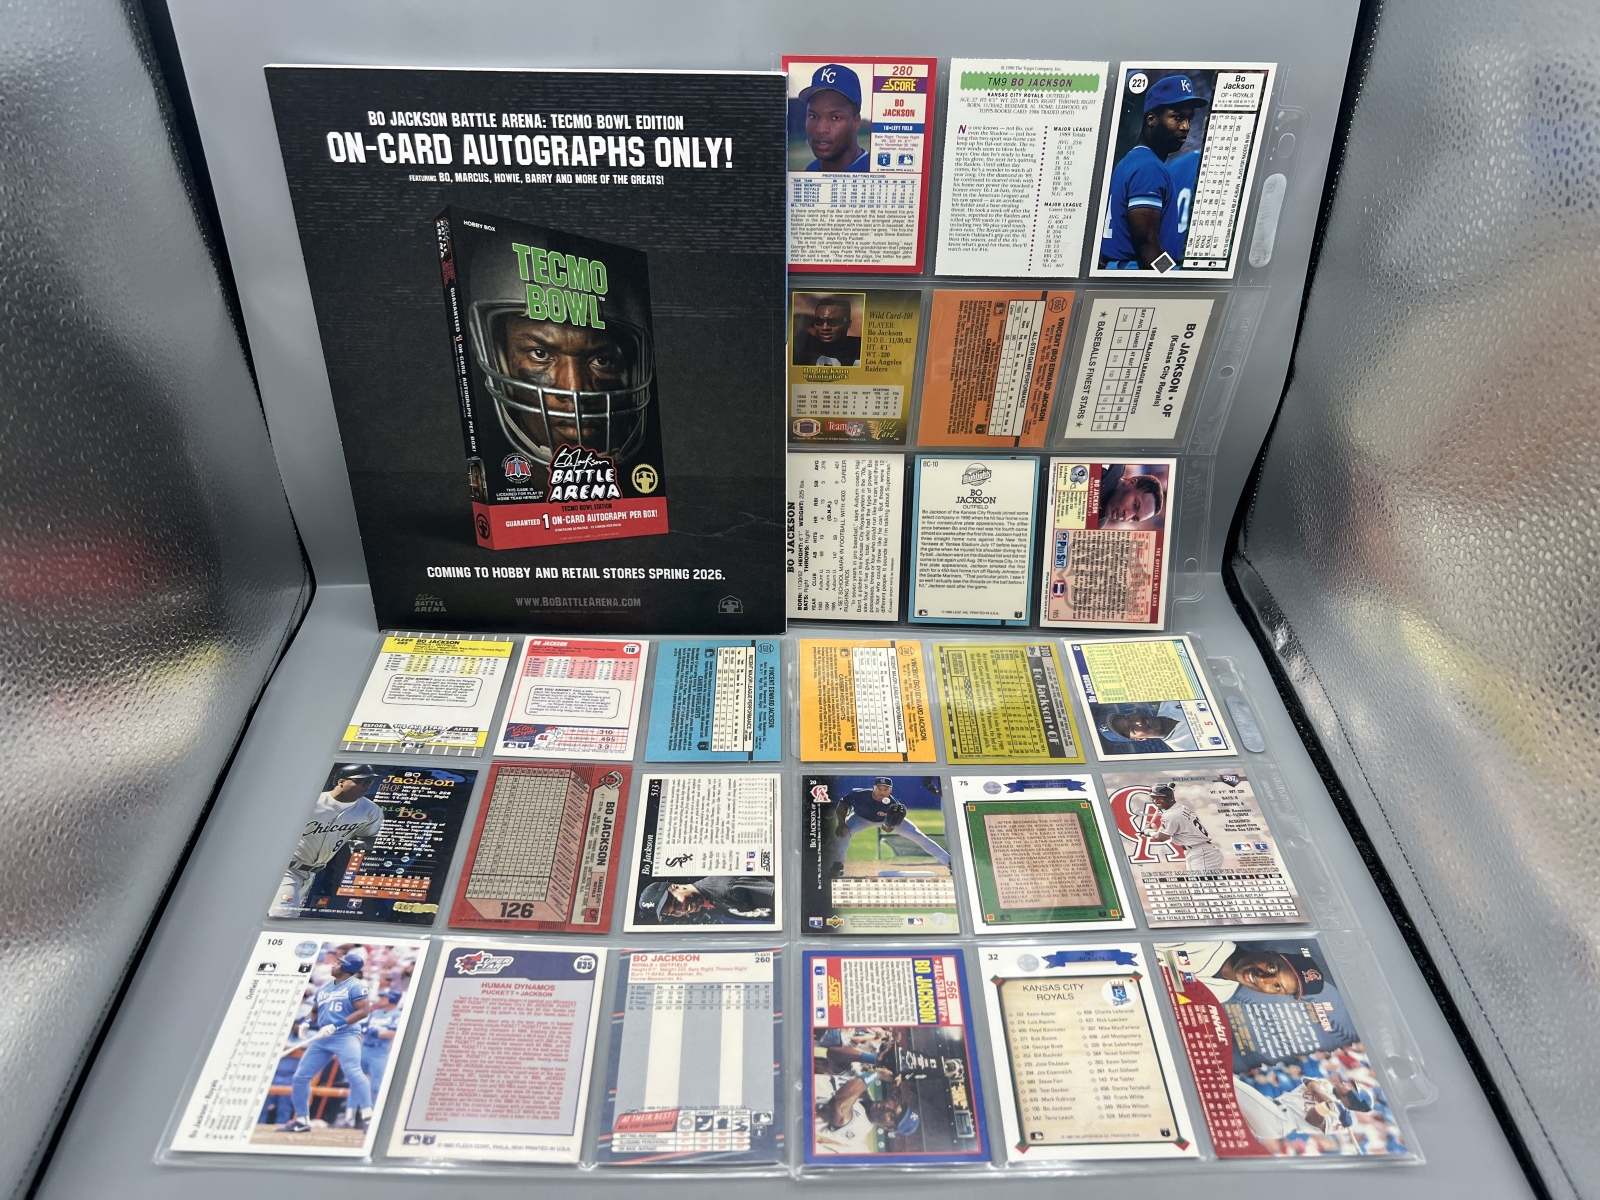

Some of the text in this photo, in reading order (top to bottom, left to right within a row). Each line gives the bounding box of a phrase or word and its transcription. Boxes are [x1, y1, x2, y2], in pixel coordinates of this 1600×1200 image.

[892, 66, 913, 76] 280
[881, 78, 917, 91] SCORE
[988, 77, 1073, 87] TM9 BO JACKSON
[1132, 78, 1146, 88] 221
[1223, 82, 1255, 90] Jackson
[1235, 75, 1246, 83] Bo
[894, 99, 904, 107] BO
[368, 111, 683, 130] BO JACKSON BATTLE ARENA: TECMO BOWL EDITION
[882, 109, 915, 117] JACKSON
[326, 132, 734, 168] ON-CARD AUTOGRAPHS ONLY!
[409, 173, 664, 185] FEATURING BO, MARCUS, HOWIE, BARRY AND MORE OF THE GREATS!
[463, 220, 483, 228] HOBBY
[512, 242, 608, 295] TECMO
[525, 283, 606, 330] BOWL
[878, 329, 903, 337] Jackson
[1143, 341, 1154, 362] MAJOR
[978, 338, 992, 401] CAREER HIGHLIGHTS
[1018, 331, 1039, 409] ALL-STAR GAME PERFORMANCE
[1038, 317, 1066, 422] VINCENT (BO) EDWARD JACKSON
[1076, 320, 1106, 420] BASEBALLS FINEST STARS
[1138, 362, 1148, 384] LEAGUE
[1152, 334, 1179, 407] (Kansas City Royals)
[1162, 323, 1197, 418] BO JACKSON OF
[1131, 385, 1143, 415] STATISTICS
[551, 469, 615, 484] BATTLE
[1093, 479, 1100, 487] BO
[550, 484, 620, 501] ARENA
[955, 496, 997, 504] JACKSON
[505, 519, 540, 527] GUARANTEED
[542, 514, 550, 529] 1
[552, 514, 585, 525] ON-CARD
[587, 512, 627, 522] AUTOGRAPH
[643, 510, 658, 518] BOX!
[786, 501, 796, 573] BO JACKSON
[427, 567, 726, 581] COMING TO HOBBY AND RETAIL STORES SPRING 2026.
[1052, 609, 1060, 618] 185
[1032, 668, 1042, 681] Bo
[1082, 674, 1098, 703] BO JACKSON
[1036, 681, 1052, 723] Jackson
[1047, 731, 1060, 745] OF
[382, 775, 455, 788] Jackson
[302, 821, 367, 837] Chicago
[597, 801, 615, 866] BO JACKSON
[333, 840, 342, 852] 8
[642, 834, 654, 875] Bo Jackson
[500, 902, 534, 918] 126
[587, 909, 598, 922] OF
[633, 954, 700, 962] BO JACKSON
[987, 953, 999, 961] 32
[246, 979, 259, 1000] Outfield
[481, 982, 556, 991] HUMAN DYNAMOS
[828, 975, 842, 1007] SCORE
[914, 959, 937, 1023] BO JACKSON
[945, 980, 958, 1000] 566
[1022, 983, 1084, 992] KANSAS CITY
[1036, 993, 1075, 1001] ROYALS
[328, 1001, 343, 1012] 16
[1207, 1004, 1228, 1044] PINNACLE
[1313, 1002, 1333, 1032] JACKSON
[633, 1114, 653, 1122] THEIR
[654, 1113, 676, 1121] BEST!
